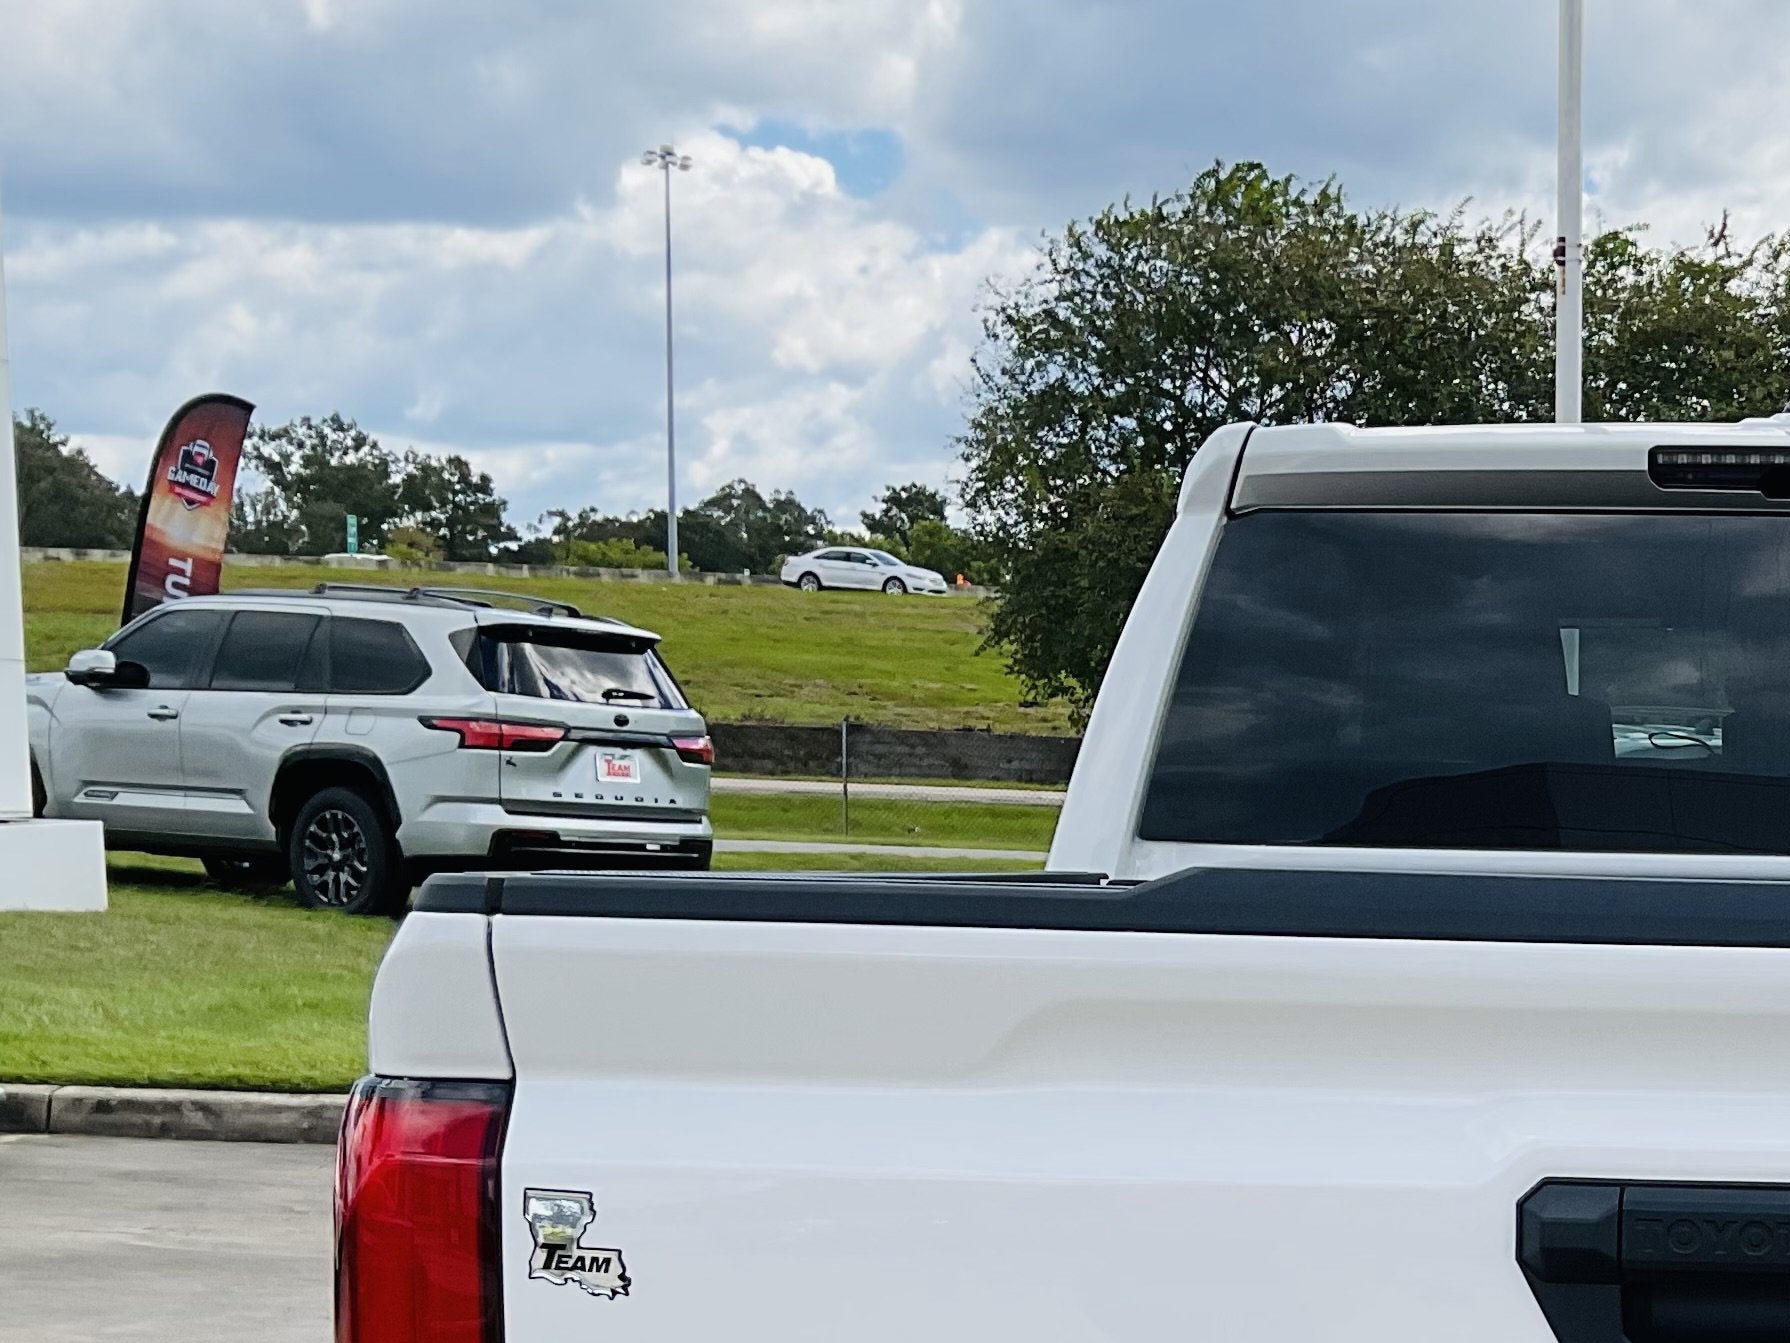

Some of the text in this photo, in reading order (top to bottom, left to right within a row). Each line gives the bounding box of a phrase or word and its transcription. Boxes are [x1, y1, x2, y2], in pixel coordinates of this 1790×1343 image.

[162, 557, 193, 603] TU
[604, 758, 631, 773] TEAM
[552, 791, 677, 804] SEQUOIA
[539, 1242, 612, 1274] TEAM
